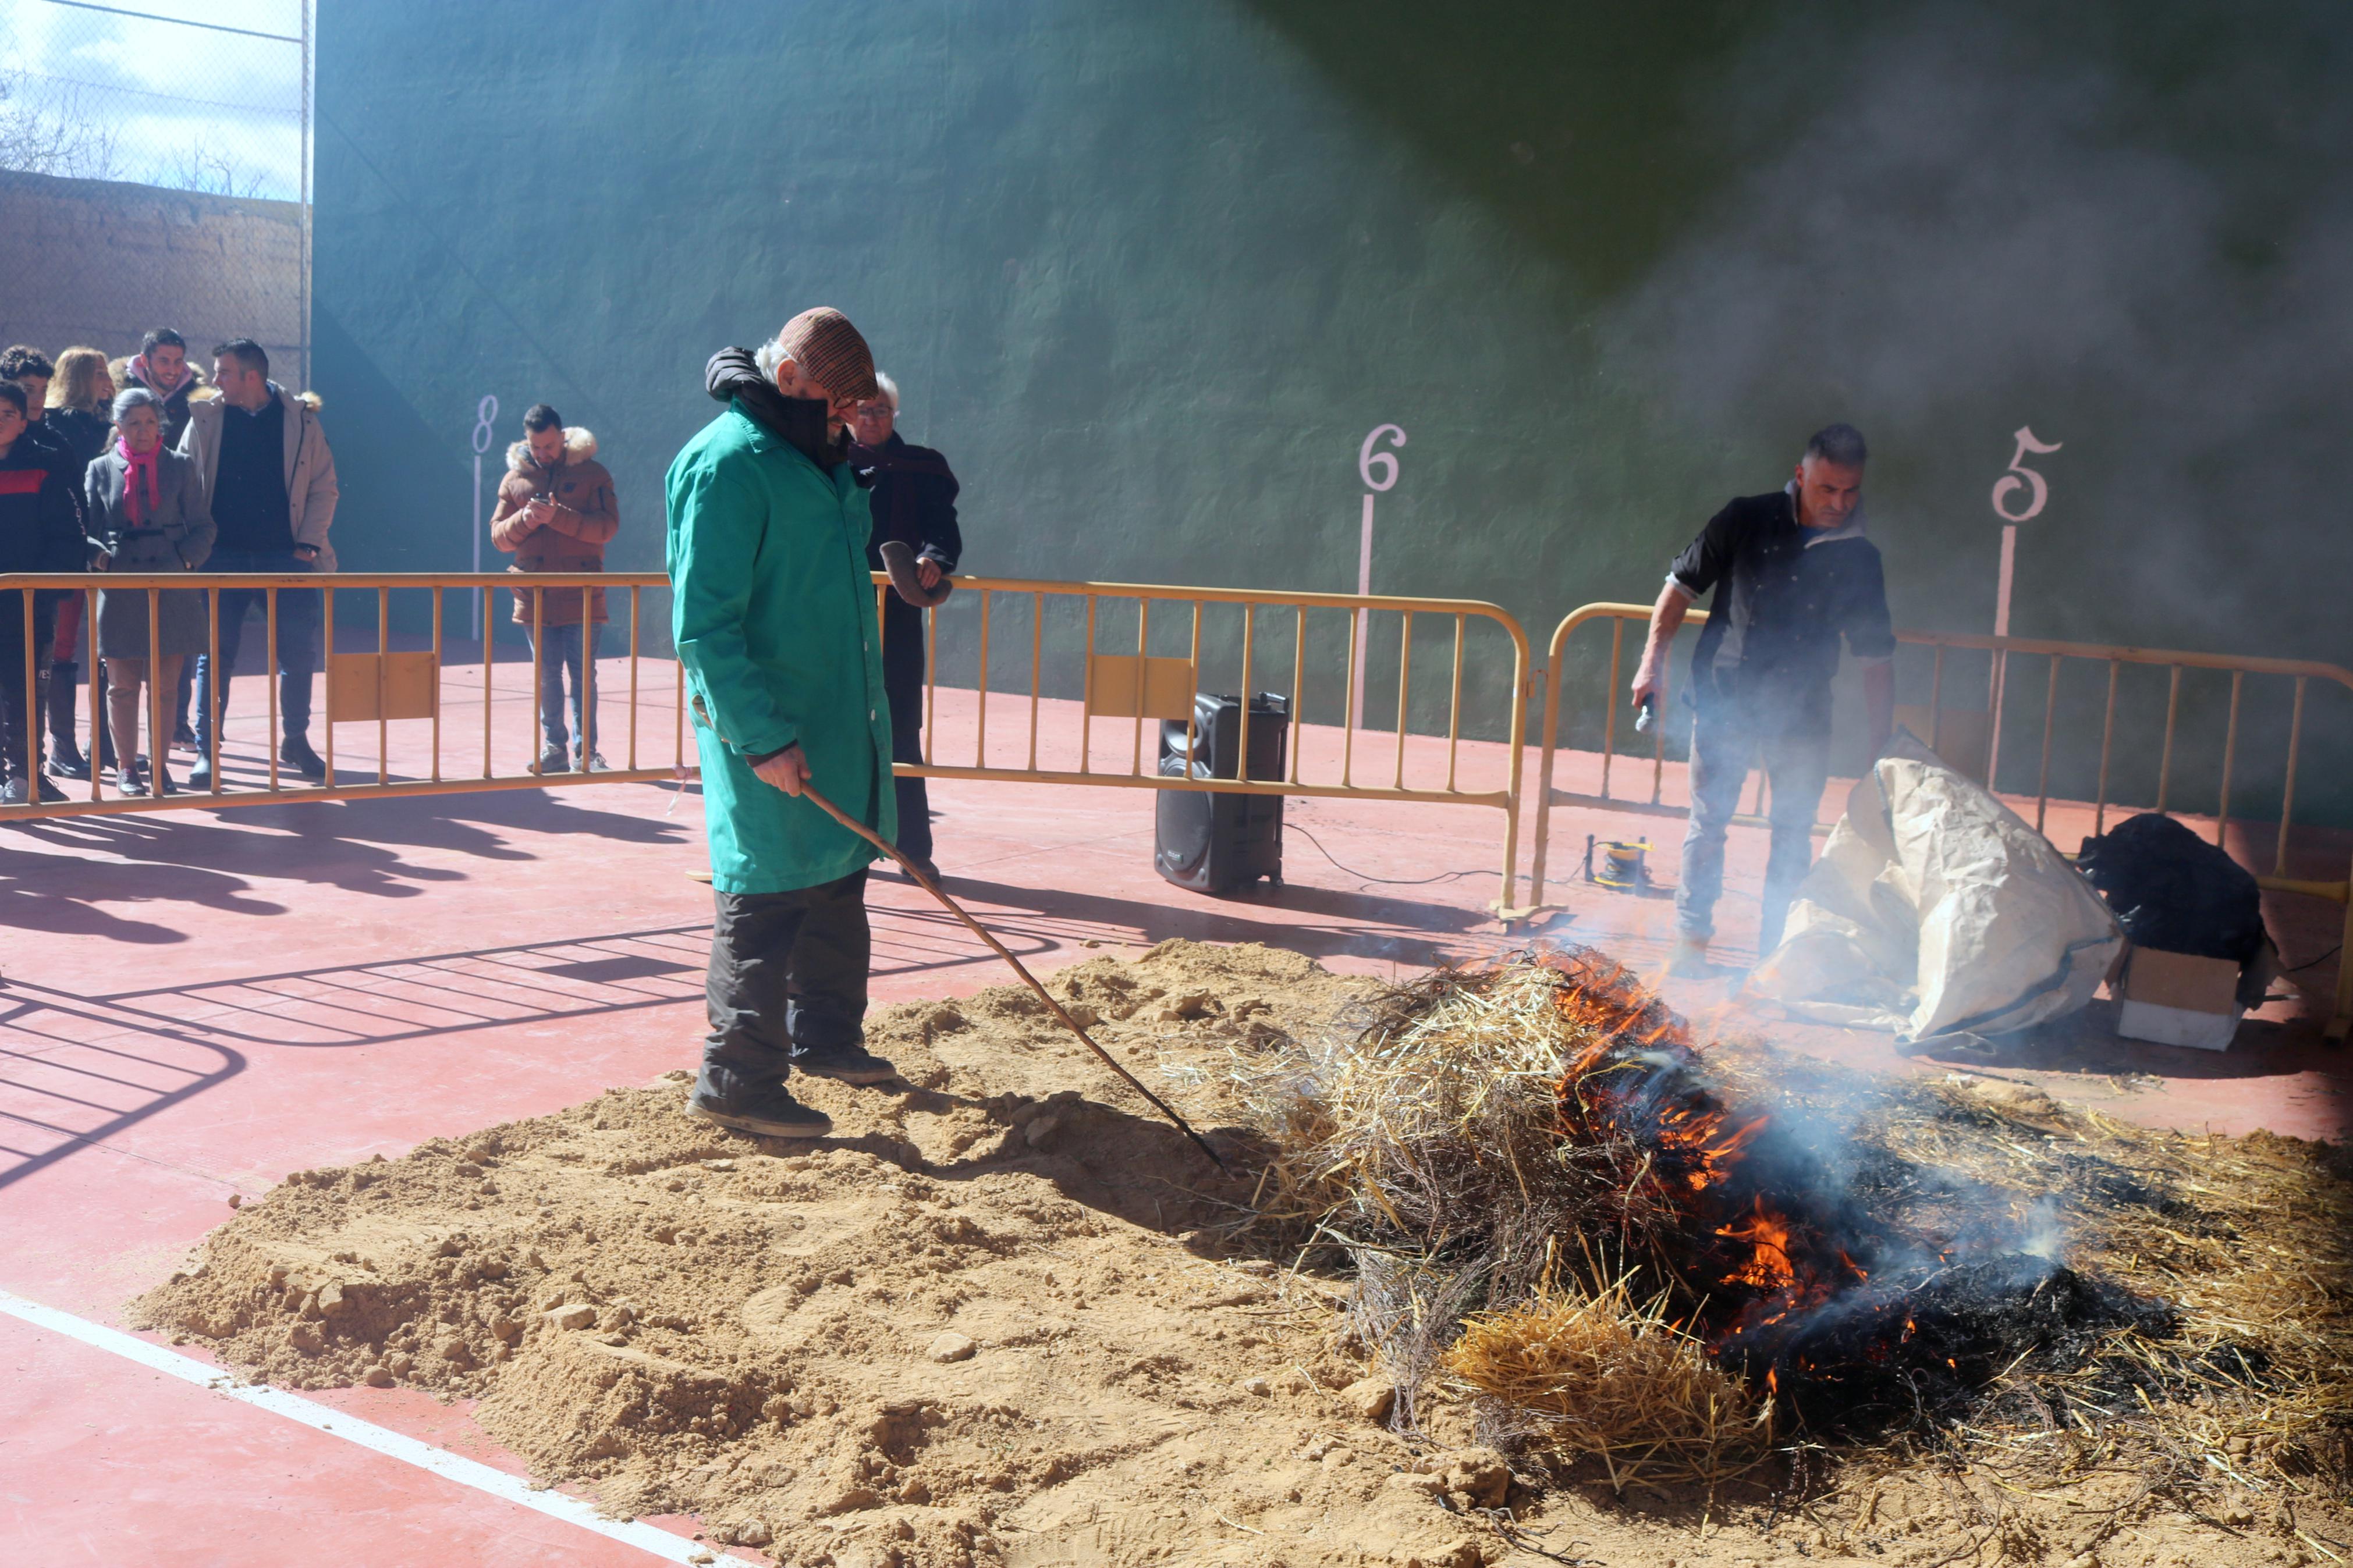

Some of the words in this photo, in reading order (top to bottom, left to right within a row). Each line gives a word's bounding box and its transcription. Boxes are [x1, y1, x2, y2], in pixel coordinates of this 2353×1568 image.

[472, 394, 498, 453] 8
[1359, 423, 1407, 492] 6
[1992, 425, 2063, 521] 5
